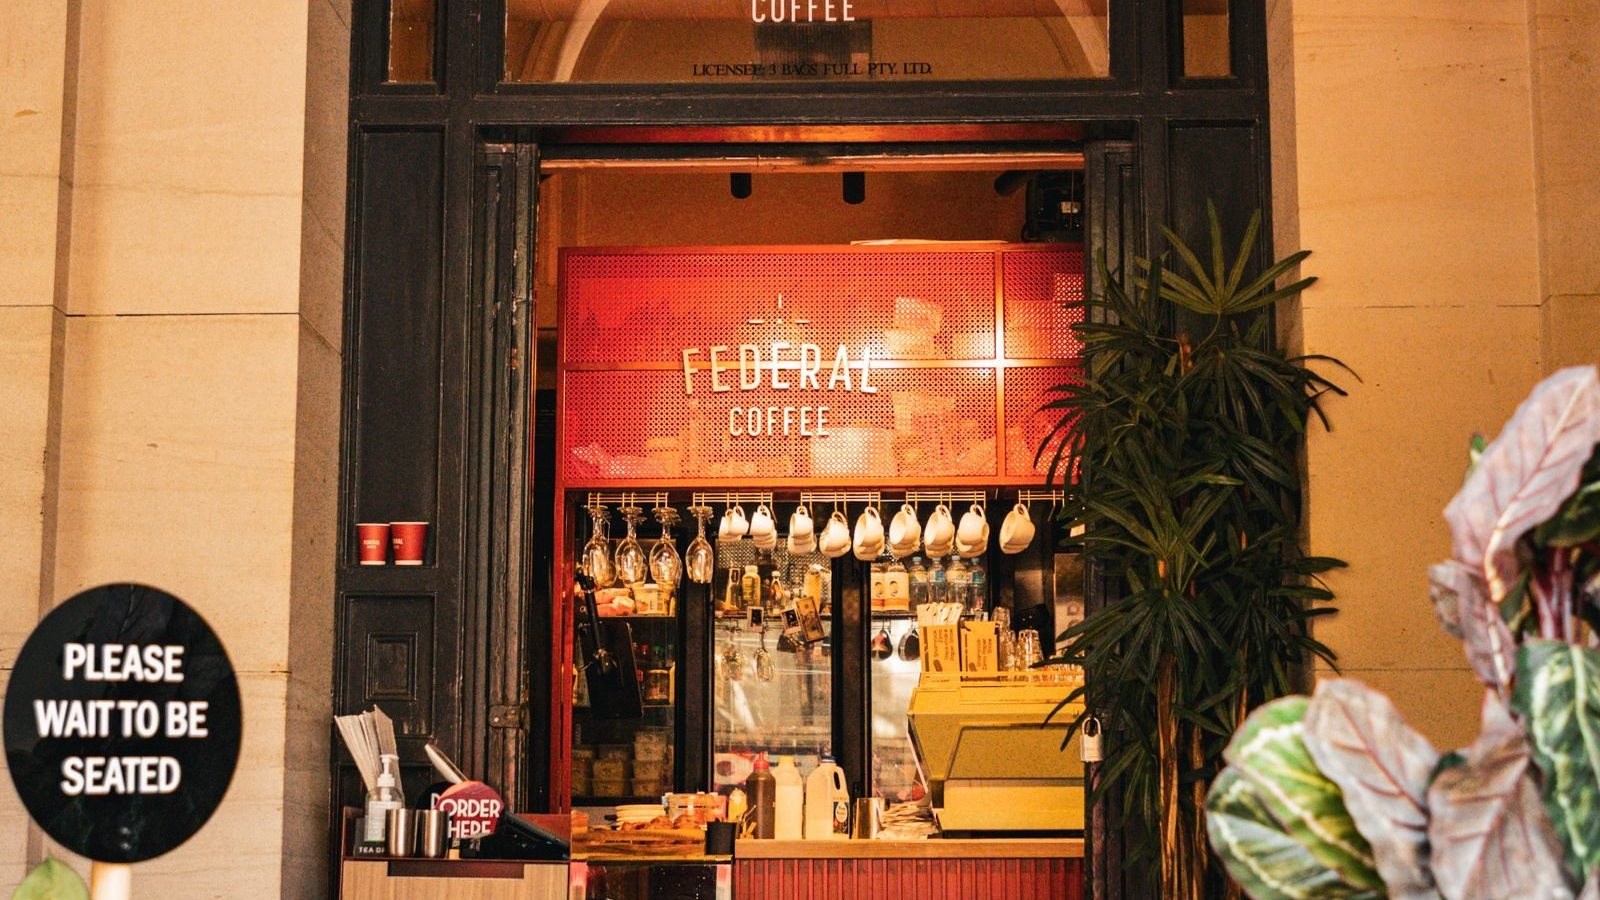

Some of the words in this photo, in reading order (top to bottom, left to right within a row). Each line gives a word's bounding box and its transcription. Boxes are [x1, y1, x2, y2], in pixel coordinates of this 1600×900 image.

[752, 0, 855, 22] COFFEE
[769, 64, 776, 76] 3
[781, 64, 818, 76] BAGS
[823, 63, 863, 75] FULL
[682, 342, 877, 395] FEDERAL
[729, 406, 830, 436] COFFEE
[63, 643, 184, 683] PLEASE
[34, 700, 115, 737] WAIT
[118, 700, 160, 737] TO
[165, 701, 208, 737] BE
[61, 756, 181, 795] SEATED
[440, 798, 500, 818] ORDER
